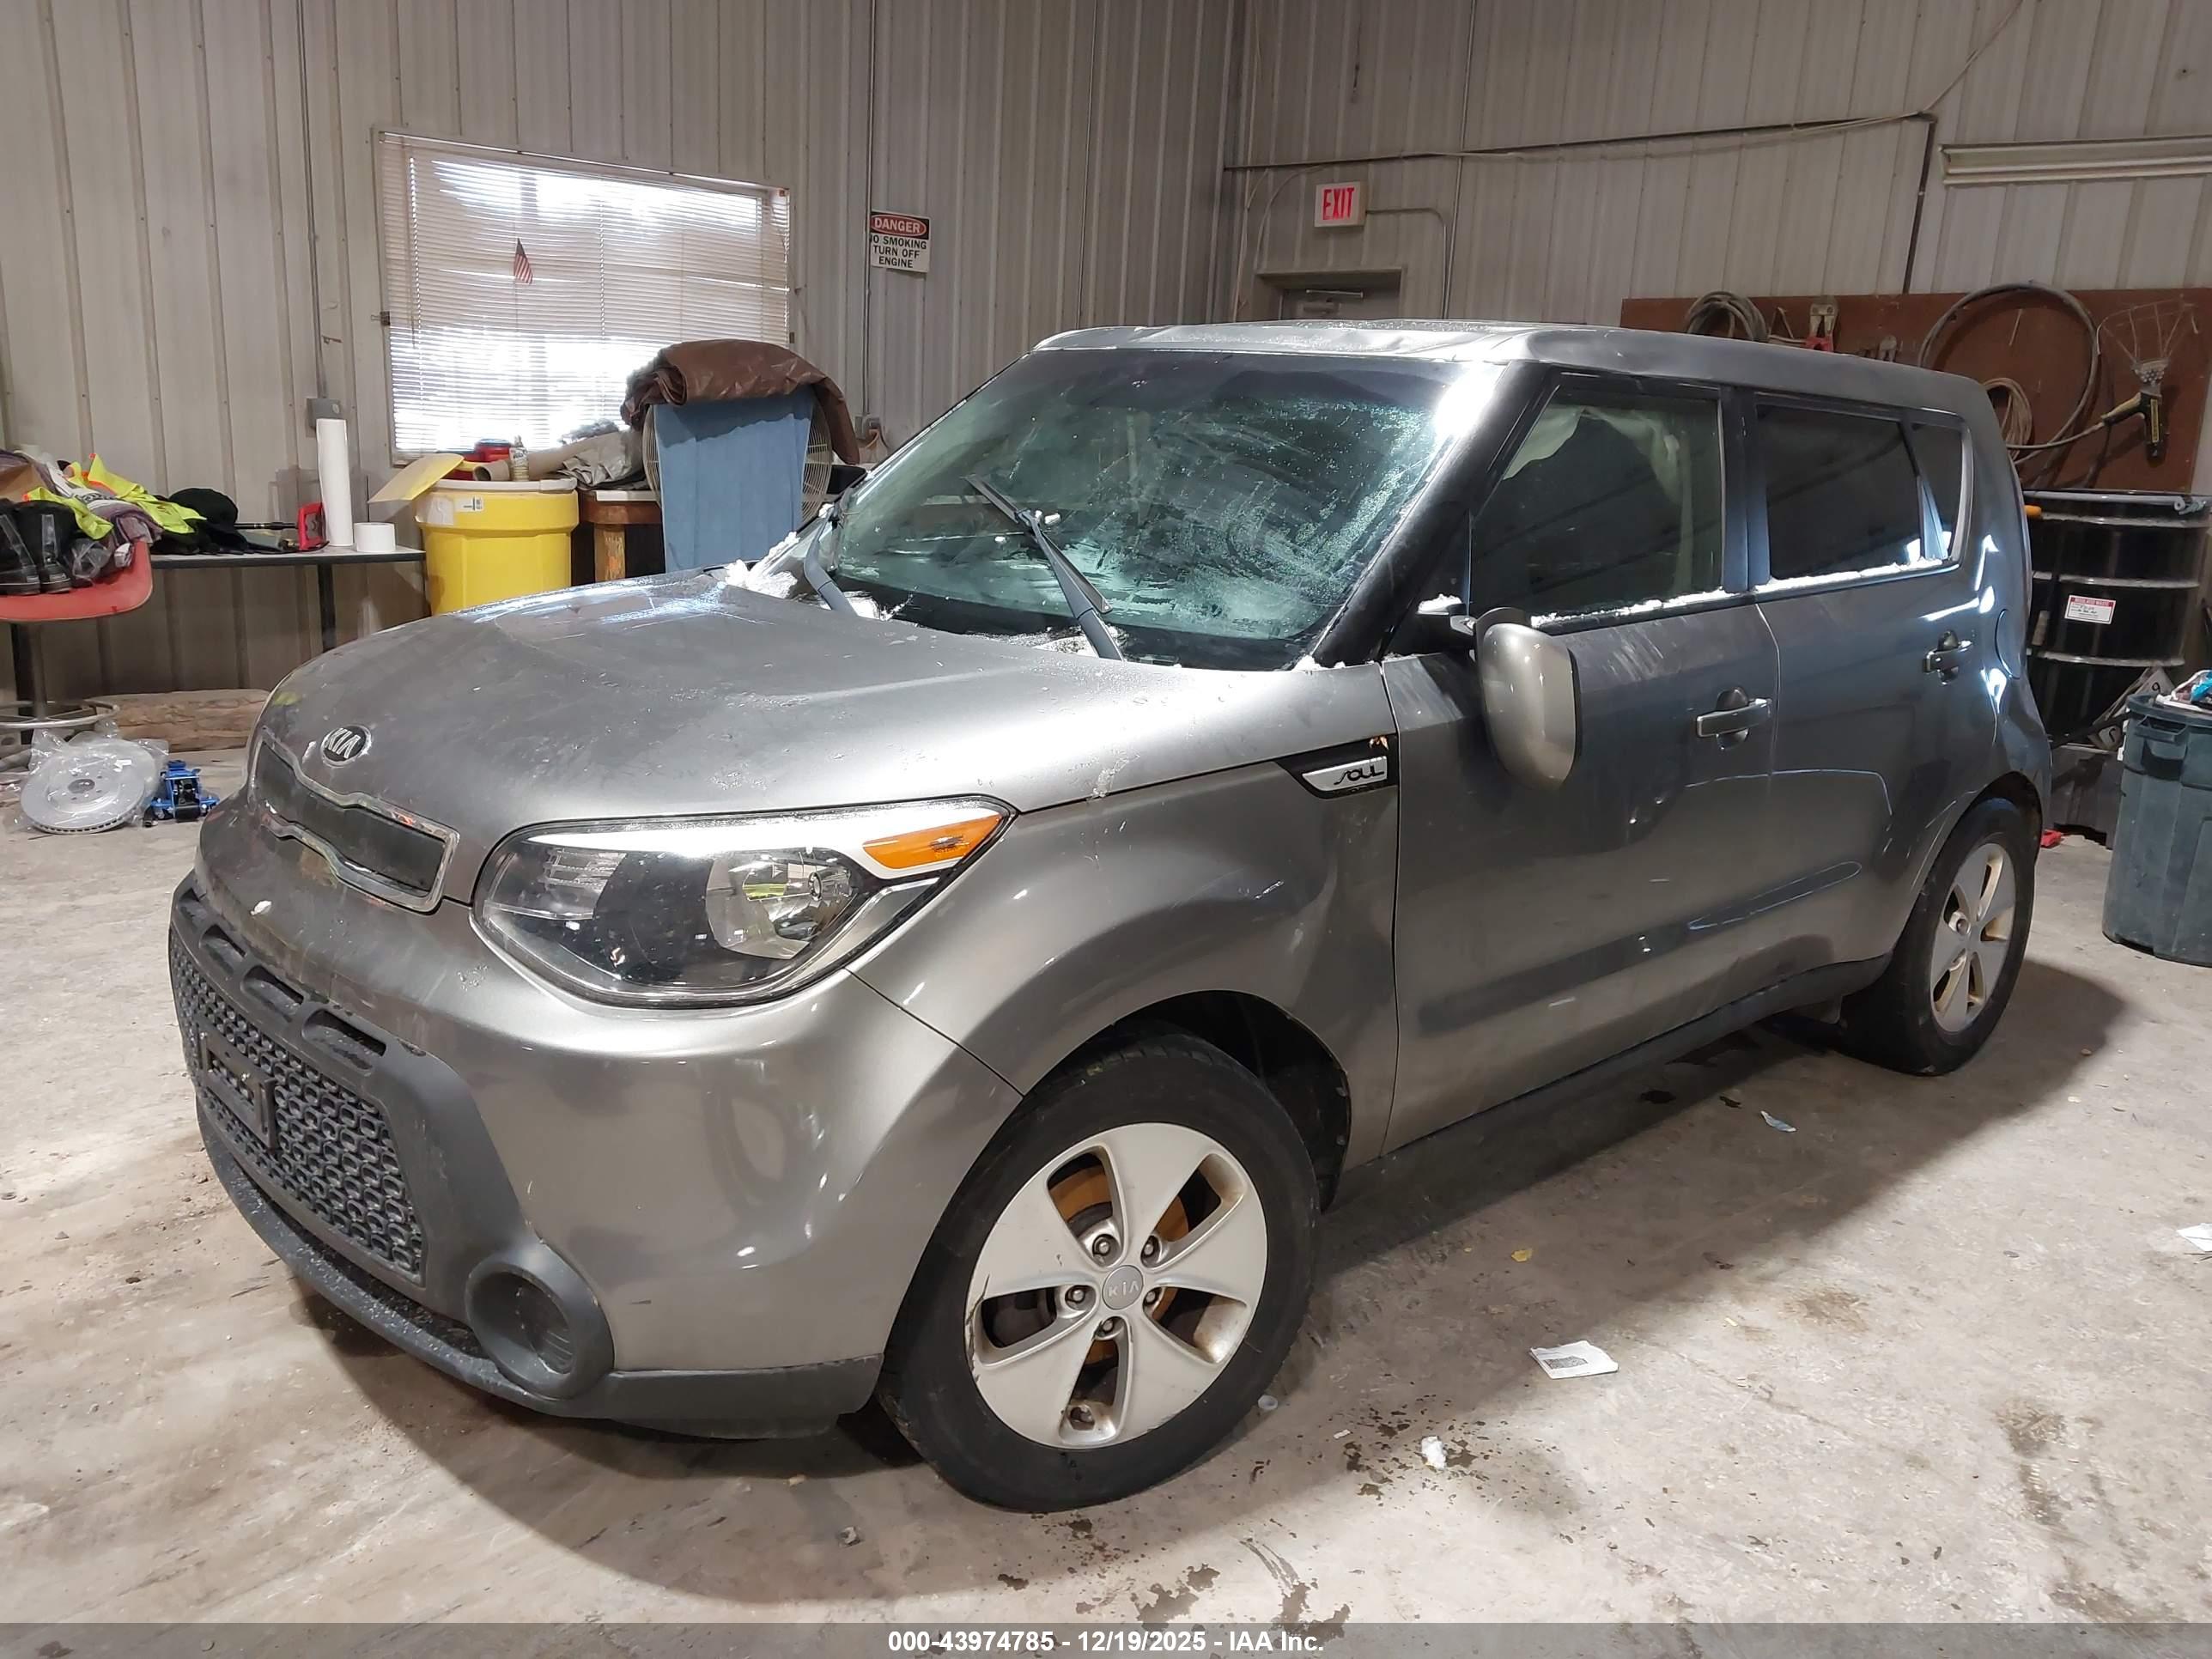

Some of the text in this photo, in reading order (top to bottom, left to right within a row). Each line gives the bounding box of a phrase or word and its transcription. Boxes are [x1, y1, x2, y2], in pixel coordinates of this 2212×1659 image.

[1323, 187, 1354, 220] EXIT
[874, 217, 921, 234] DANGER
[884, 236, 927, 249] SMOKING
[873, 245, 920, 258] TURN OFF
[879, 256, 913, 268] ENGINE
[325, 727, 361, 759] KIA
[1334, 765, 1384, 785] SOUL
[1109, 1280, 1139, 1297] KIA
